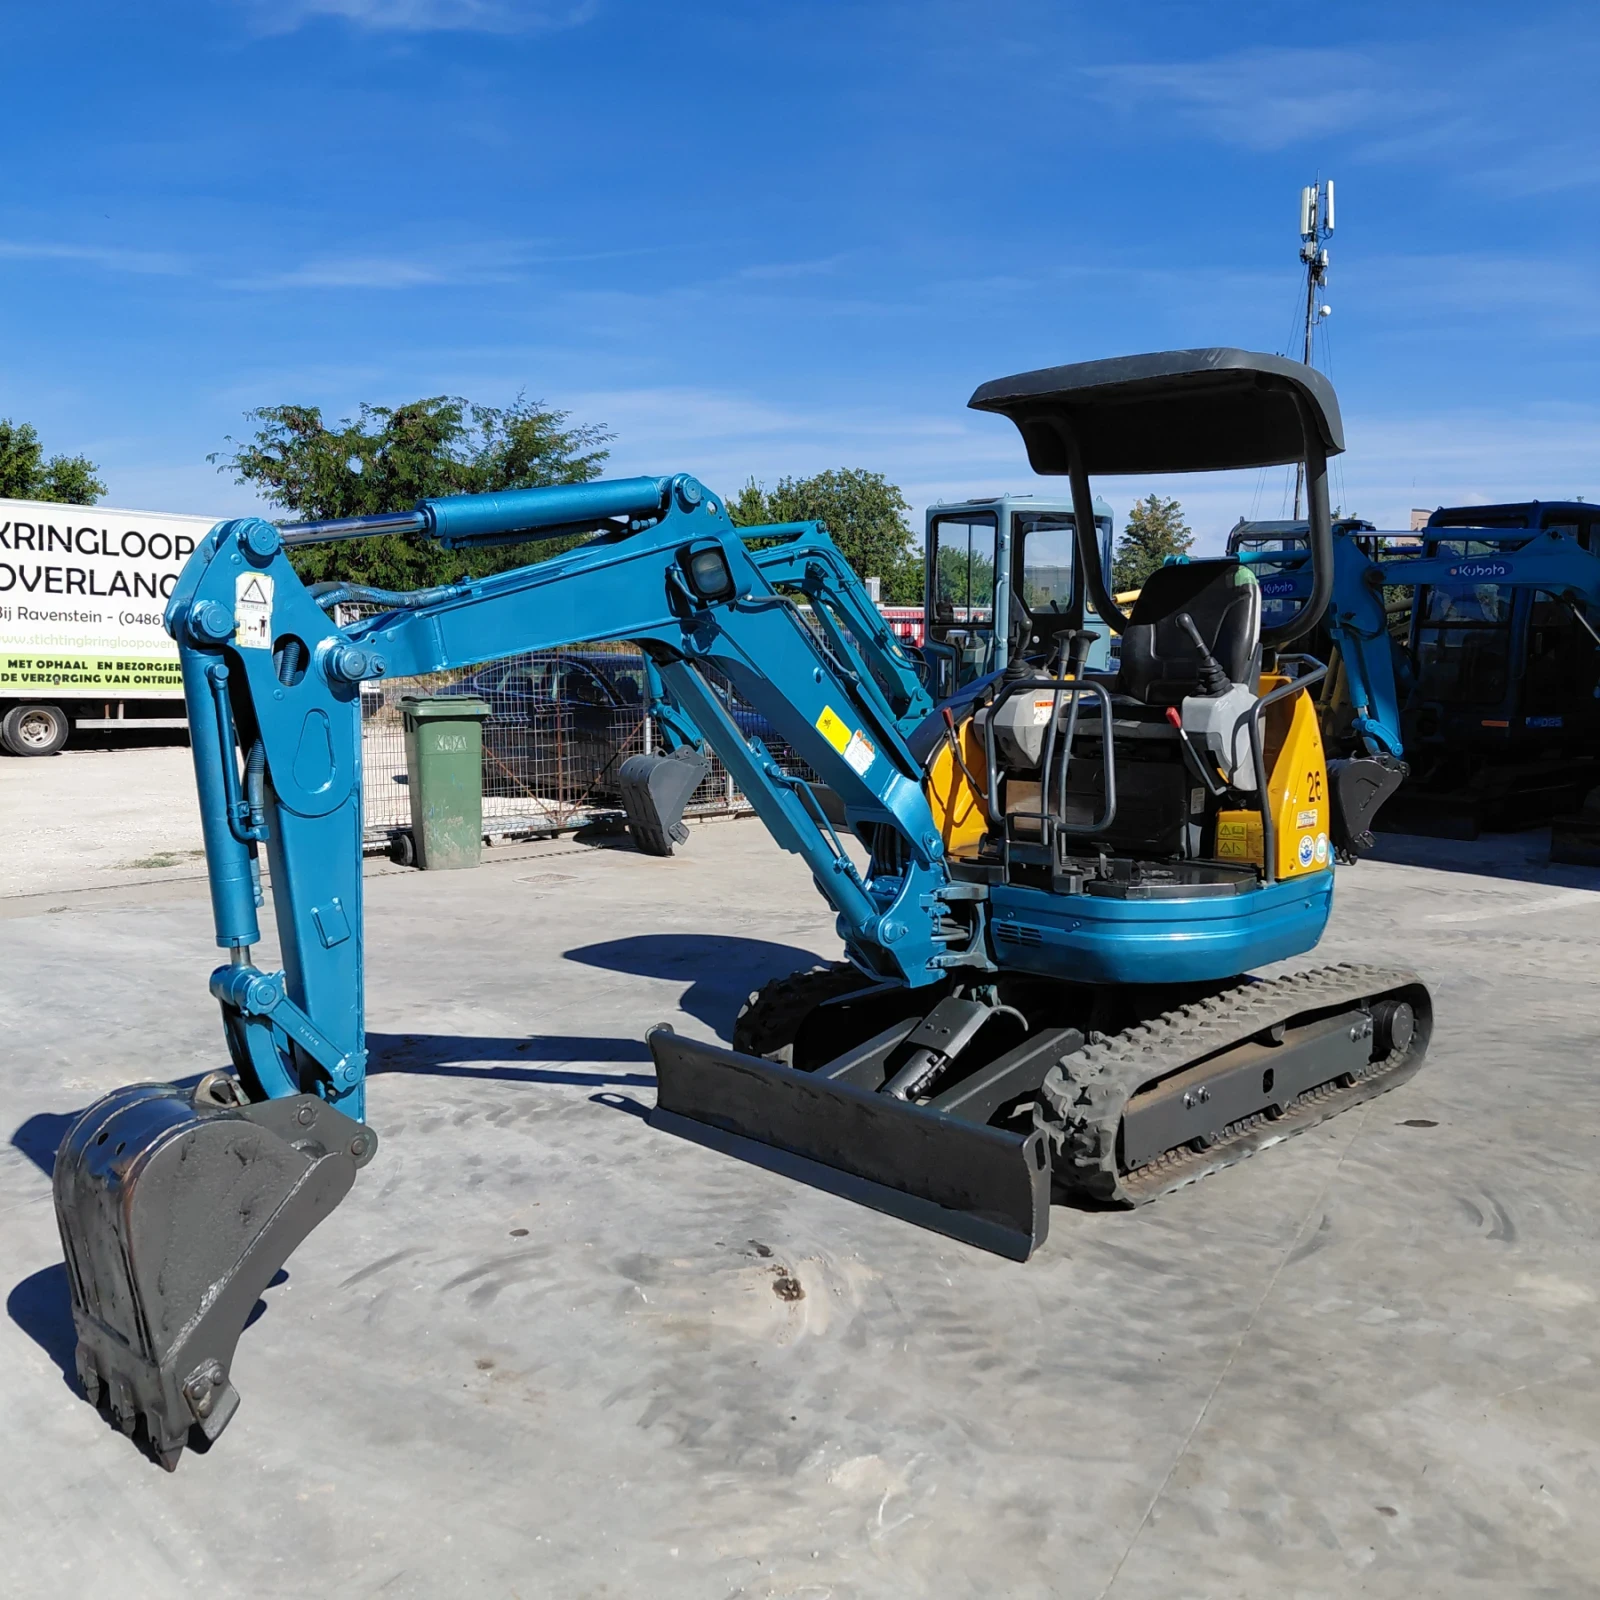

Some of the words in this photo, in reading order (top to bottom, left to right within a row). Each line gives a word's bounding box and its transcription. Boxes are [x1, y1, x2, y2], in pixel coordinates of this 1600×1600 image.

[1459, 564, 1505, 577] Kubota
[1264, 581, 1293, 594] Kubota
[18, 606, 102, 623] Ravenstein
[8, 660, 32, 669] MET
[36, 660, 88, 670] OPHAAL
[97, 662, 113, 670] EN
[1, 673, 17, 682] DE
[21, 673, 101, 684] VERZORGING
[105, 674, 130, 683] VAN
